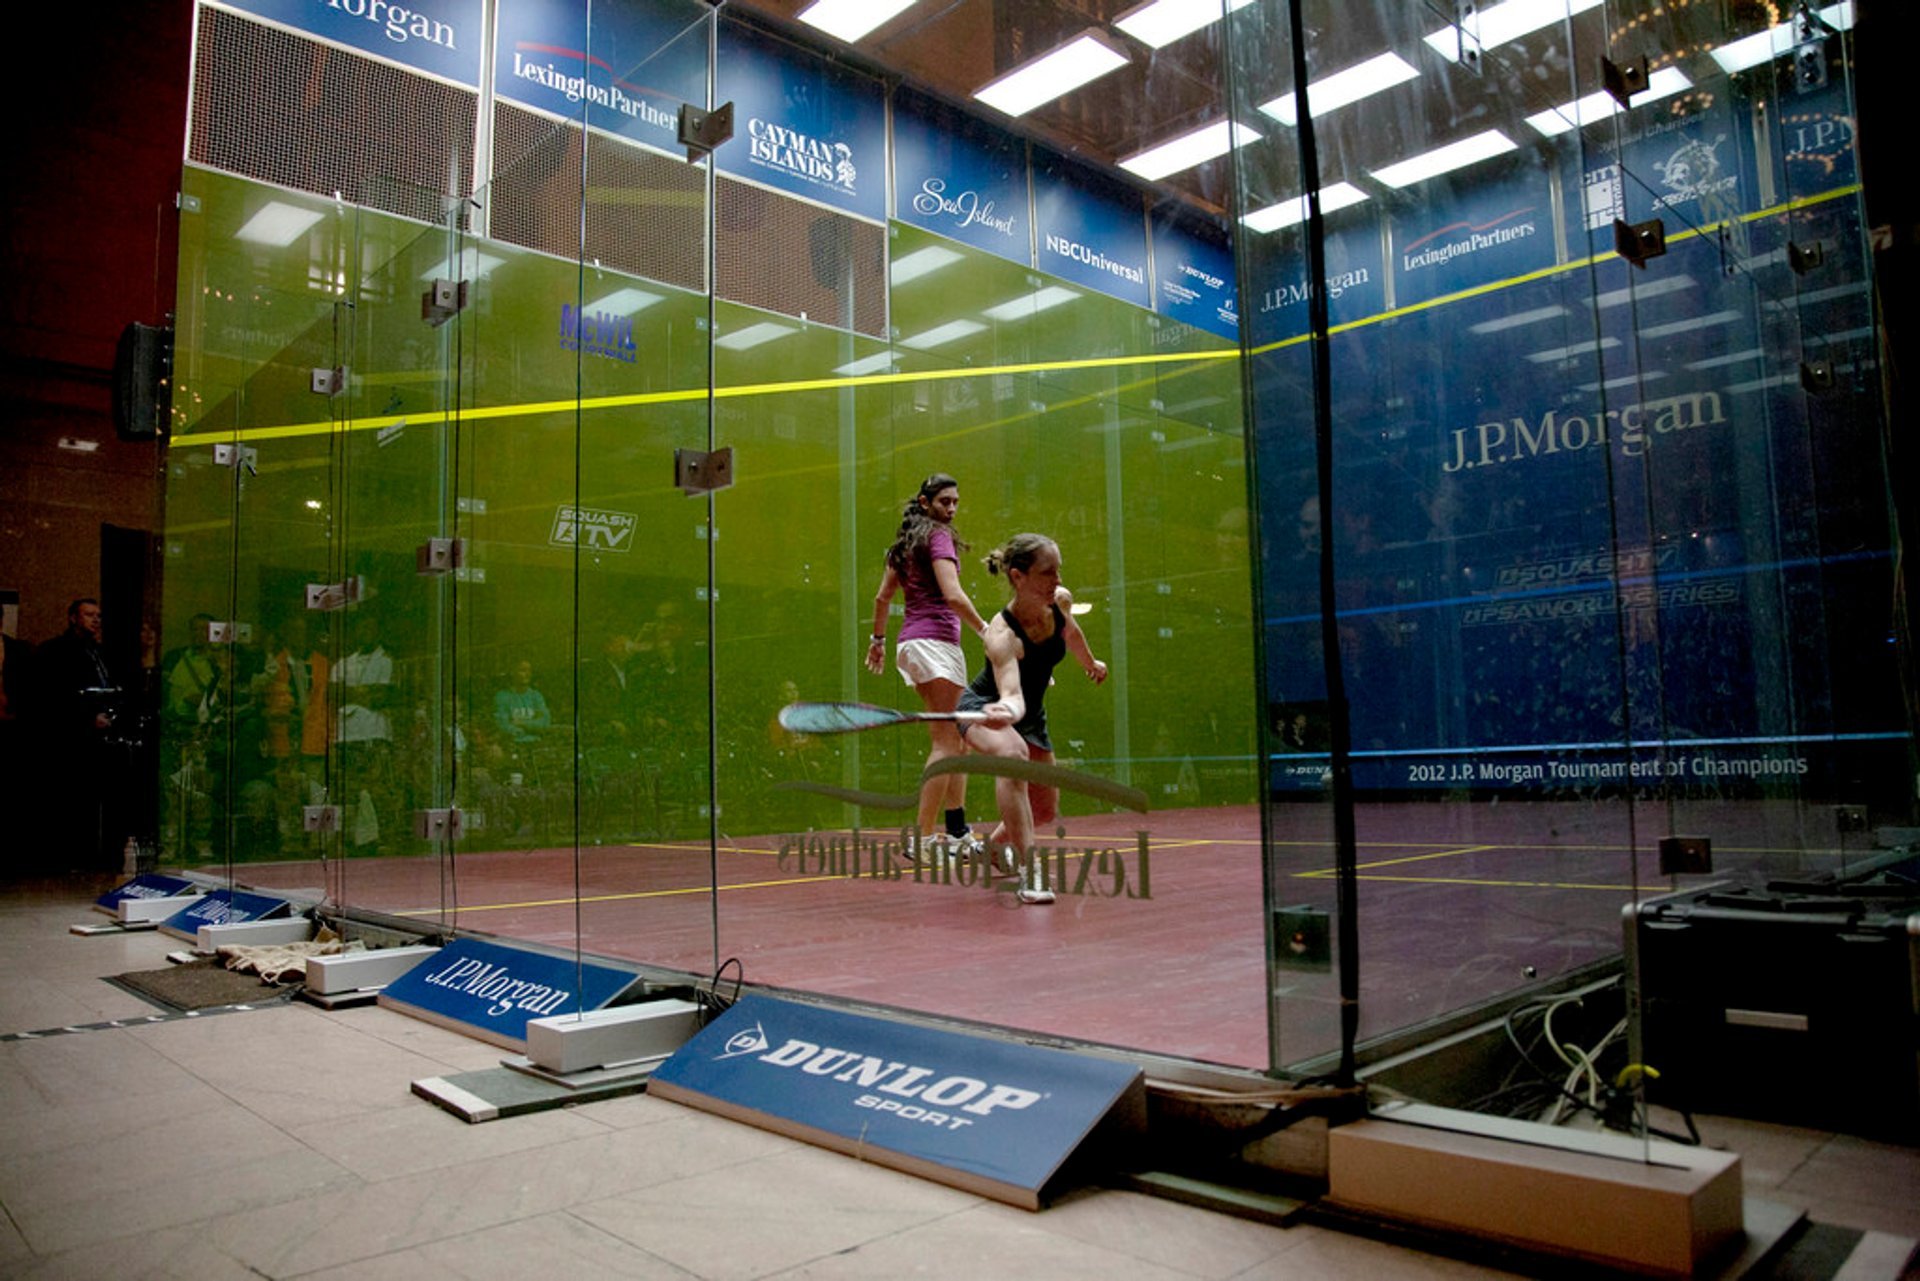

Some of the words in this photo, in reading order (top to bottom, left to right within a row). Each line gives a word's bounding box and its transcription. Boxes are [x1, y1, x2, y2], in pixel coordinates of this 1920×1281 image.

[328, 0, 456, 49] organ
[513, 53, 680, 131] LexingtonPartner
[748, 118, 834, 163] CAYMAN
[749, 137, 835, 181] ISLANDS
[913, 178, 959, 215] Sea
[955, 191, 1016, 237] Island
[1046, 234, 1144, 285] NBCUniversal
[1404, 221, 1536, 272] LexingtonPartners
[1261, 267, 1369, 313] J.P.Mgan
[1443, 390, 1727, 473] J.P.Morgan
[560, 509, 634, 527] SQUASH
[584, 524, 631, 547] TV
[1409, 765, 1445, 781] 2012
[1451, 764, 1475, 780] J.P.
[1479, 763, 1541, 783] Morgan
[1549, 759, 1662, 778] Tournament
[1666, 757, 1686, 776] of
[1692, 754, 1808, 779] Champions
[425, 956, 570, 1016] J.P.Morgan
[758, 1039, 1042, 1116] DUNLOP
[853, 1095, 974, 1131] SPORT
